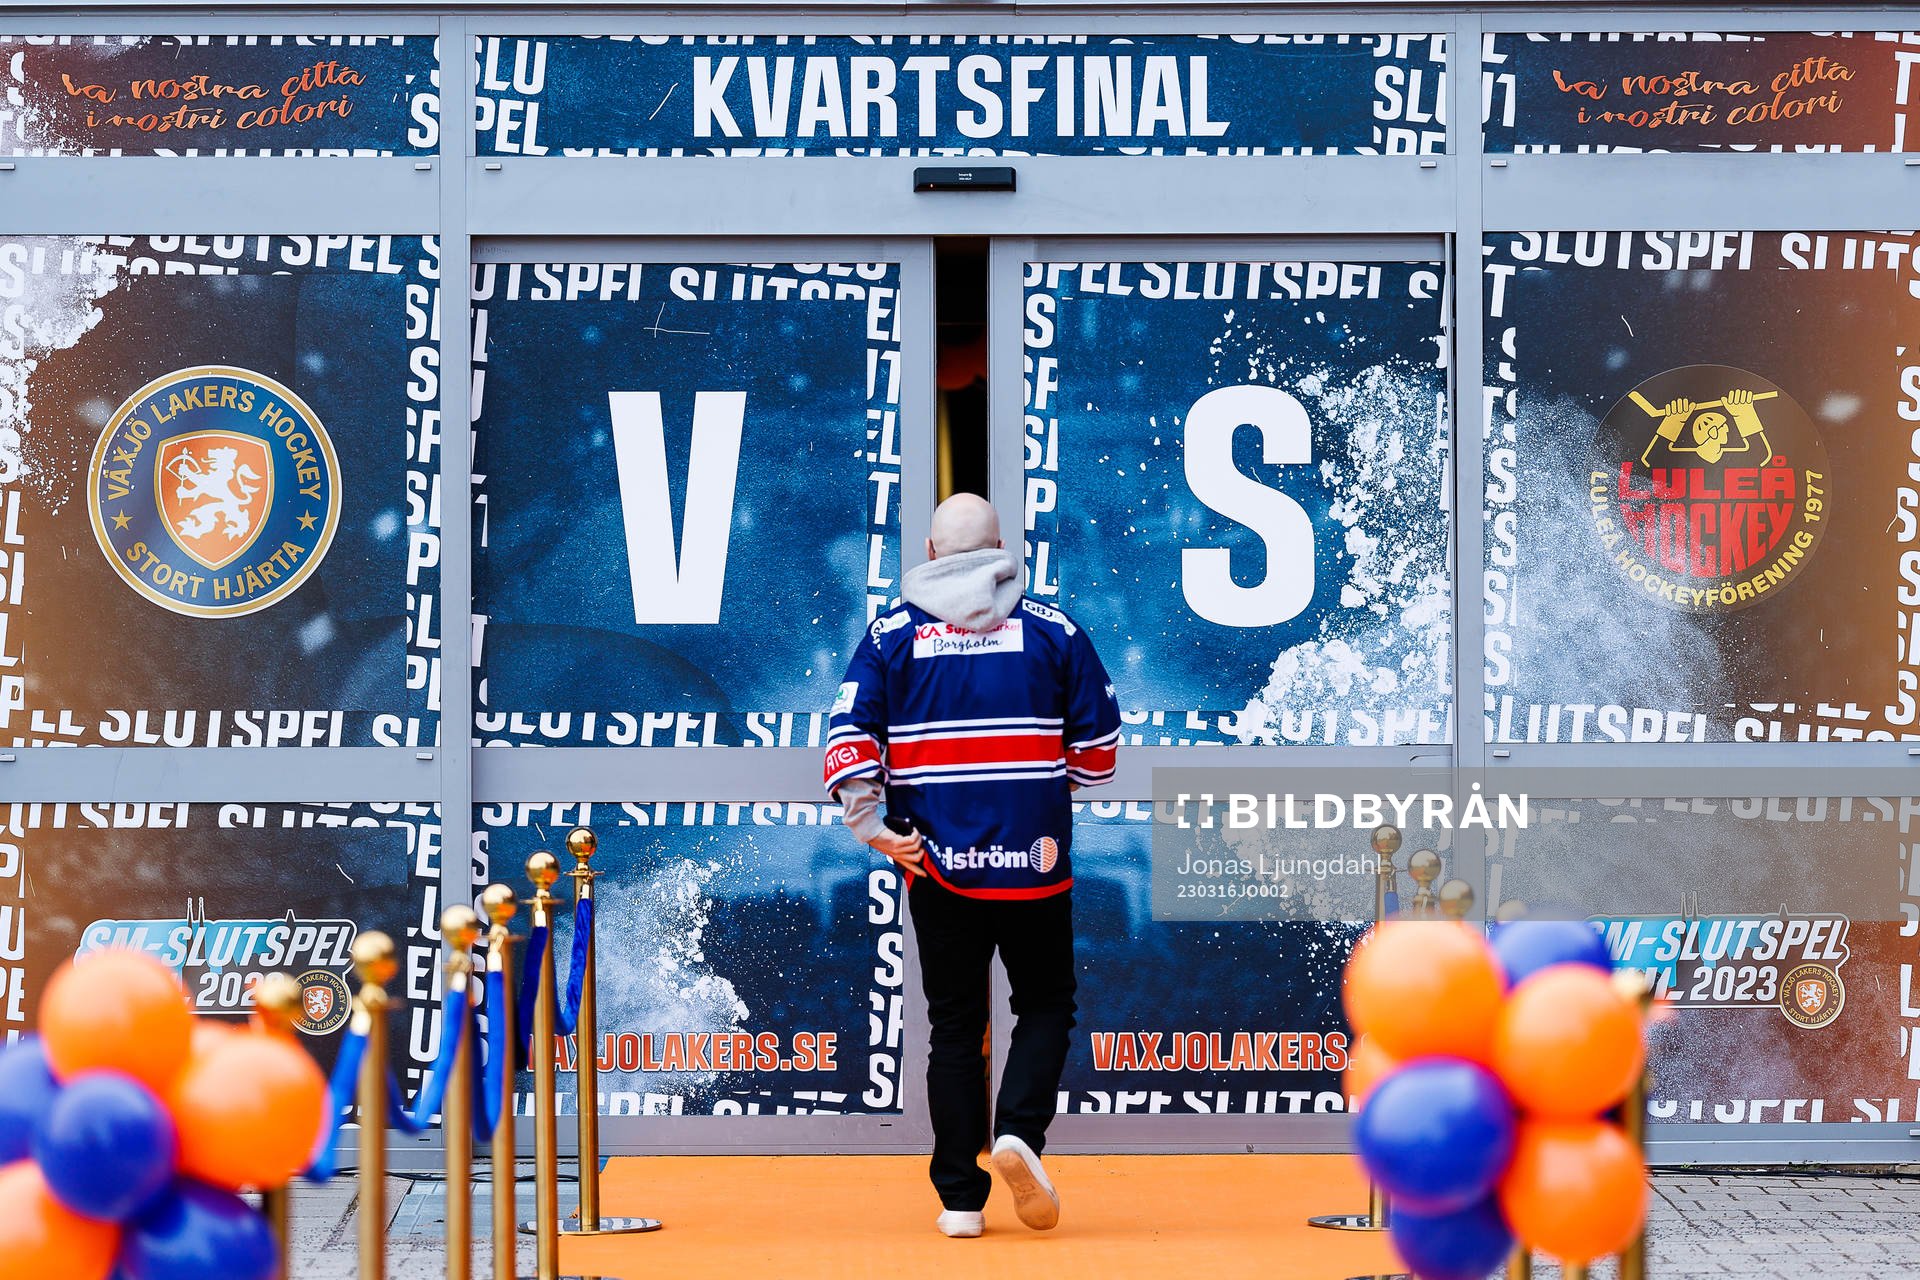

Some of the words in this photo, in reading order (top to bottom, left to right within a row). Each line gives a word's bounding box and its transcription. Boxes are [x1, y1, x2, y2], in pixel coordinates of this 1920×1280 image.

[131, 75, 269, 100] nostra
[693, 55, 1231, 138] KVARTSFINAL
[1622, 71, 1759, 96] nostra
[87, 111, 99, 128] i
[105, 105, 227, 133] nostri
[236, 95, 353, 130] colori
[1578, 107, 1591, 123] i
[1597, 101, 1717, 128] nostri
[1727, 90, 1843, 125] colori
[103, 417, 153, 501] VÄXJÖ
[151, 385, 256, 424] LAKERS
[258, 402, 322, 501] HOCKEY
[1618, 455, 1796, 500] LULEÅ
[608, 391, 747, 625] V
[1181, 384, 1315, 628] S
[1614, 530, 1814, 608] HOCKEYFÖRENING
[1805, 469, 1824, 523] 1977
[1619, 503, 1796, 579] HOCKEY
[126, 541, 205, 599] STORT
[213, 540, 306, 601] HJÄRTA
[933, 637, 1001, 653] Borgholm
[1484, 693, 1707, 742] LUTSPEL
[301, 973, 329, 985] LAKERS
[1689, 965, 1779, 1002] 2023
[1795, 967, 1822, 979] LAKERS
[1822, 971, 1839, 998] HOCKEY
[1788, 1007, 1810, 1024] STORT
[526, 1032, 838, 1073] AJOLAKERS.SE
[1090, 1031, 1349, 1071] VAXJOLAKERS
